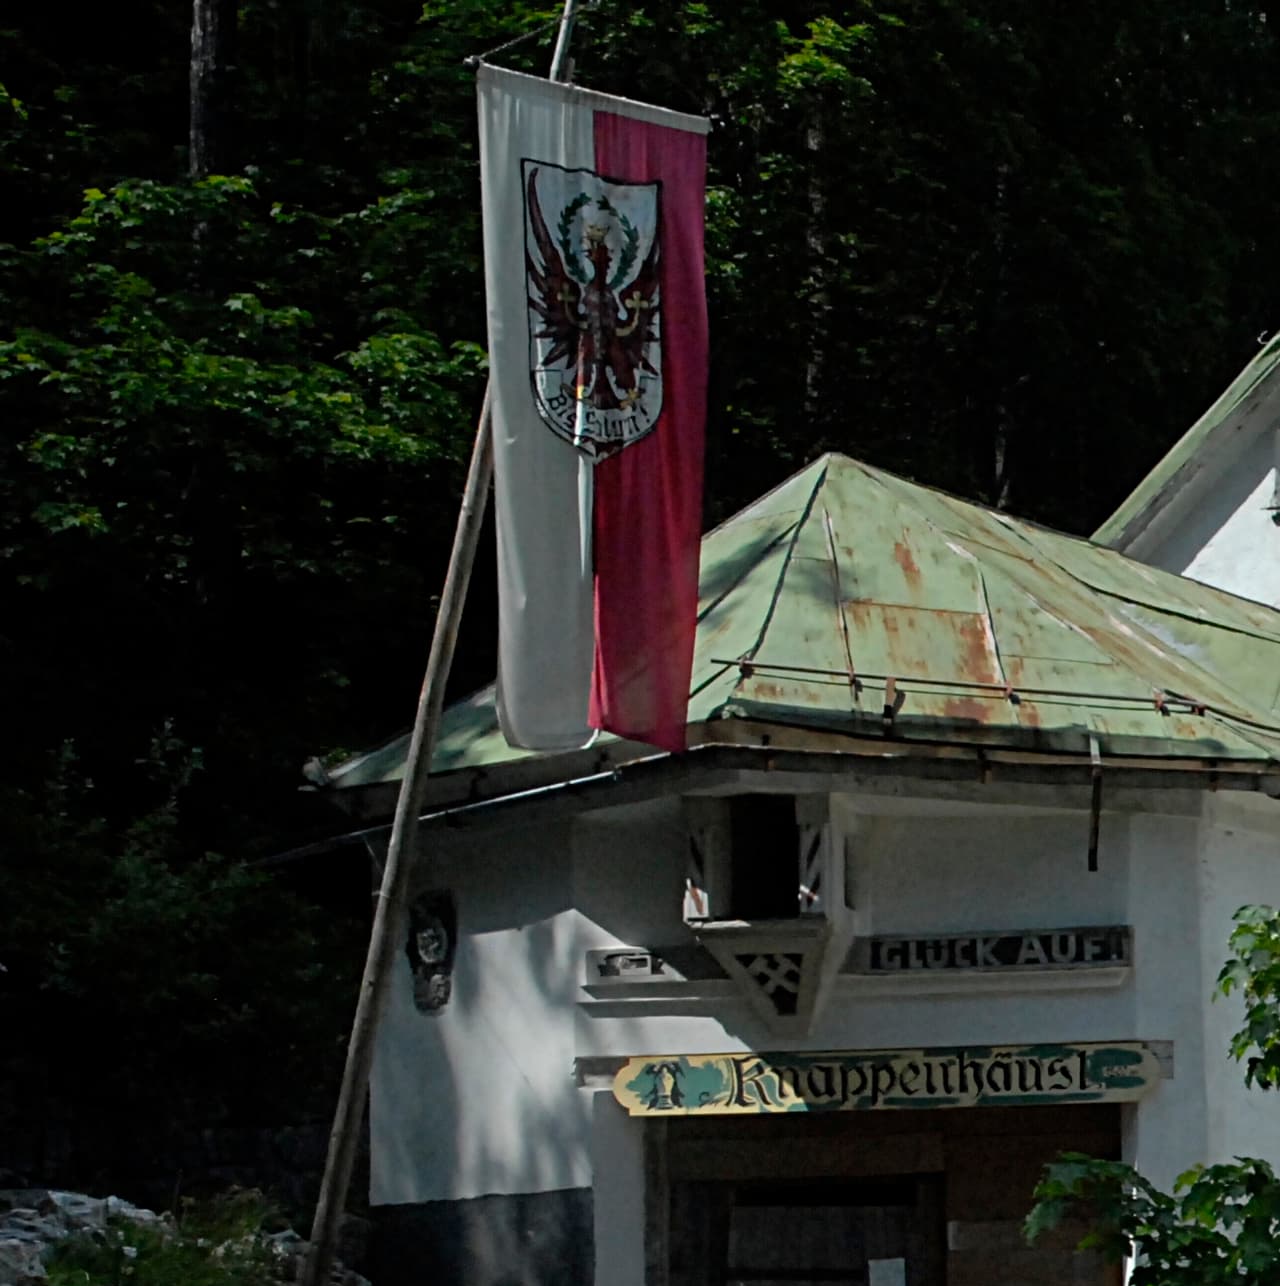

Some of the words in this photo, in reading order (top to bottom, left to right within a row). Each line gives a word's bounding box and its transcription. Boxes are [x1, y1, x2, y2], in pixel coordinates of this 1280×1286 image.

[880, 937, 1001, 968] GLÜCK
[1016, 933, 1120, 963] AUF!
[728, 1051, 1090, 1106] Knappenhäusl
